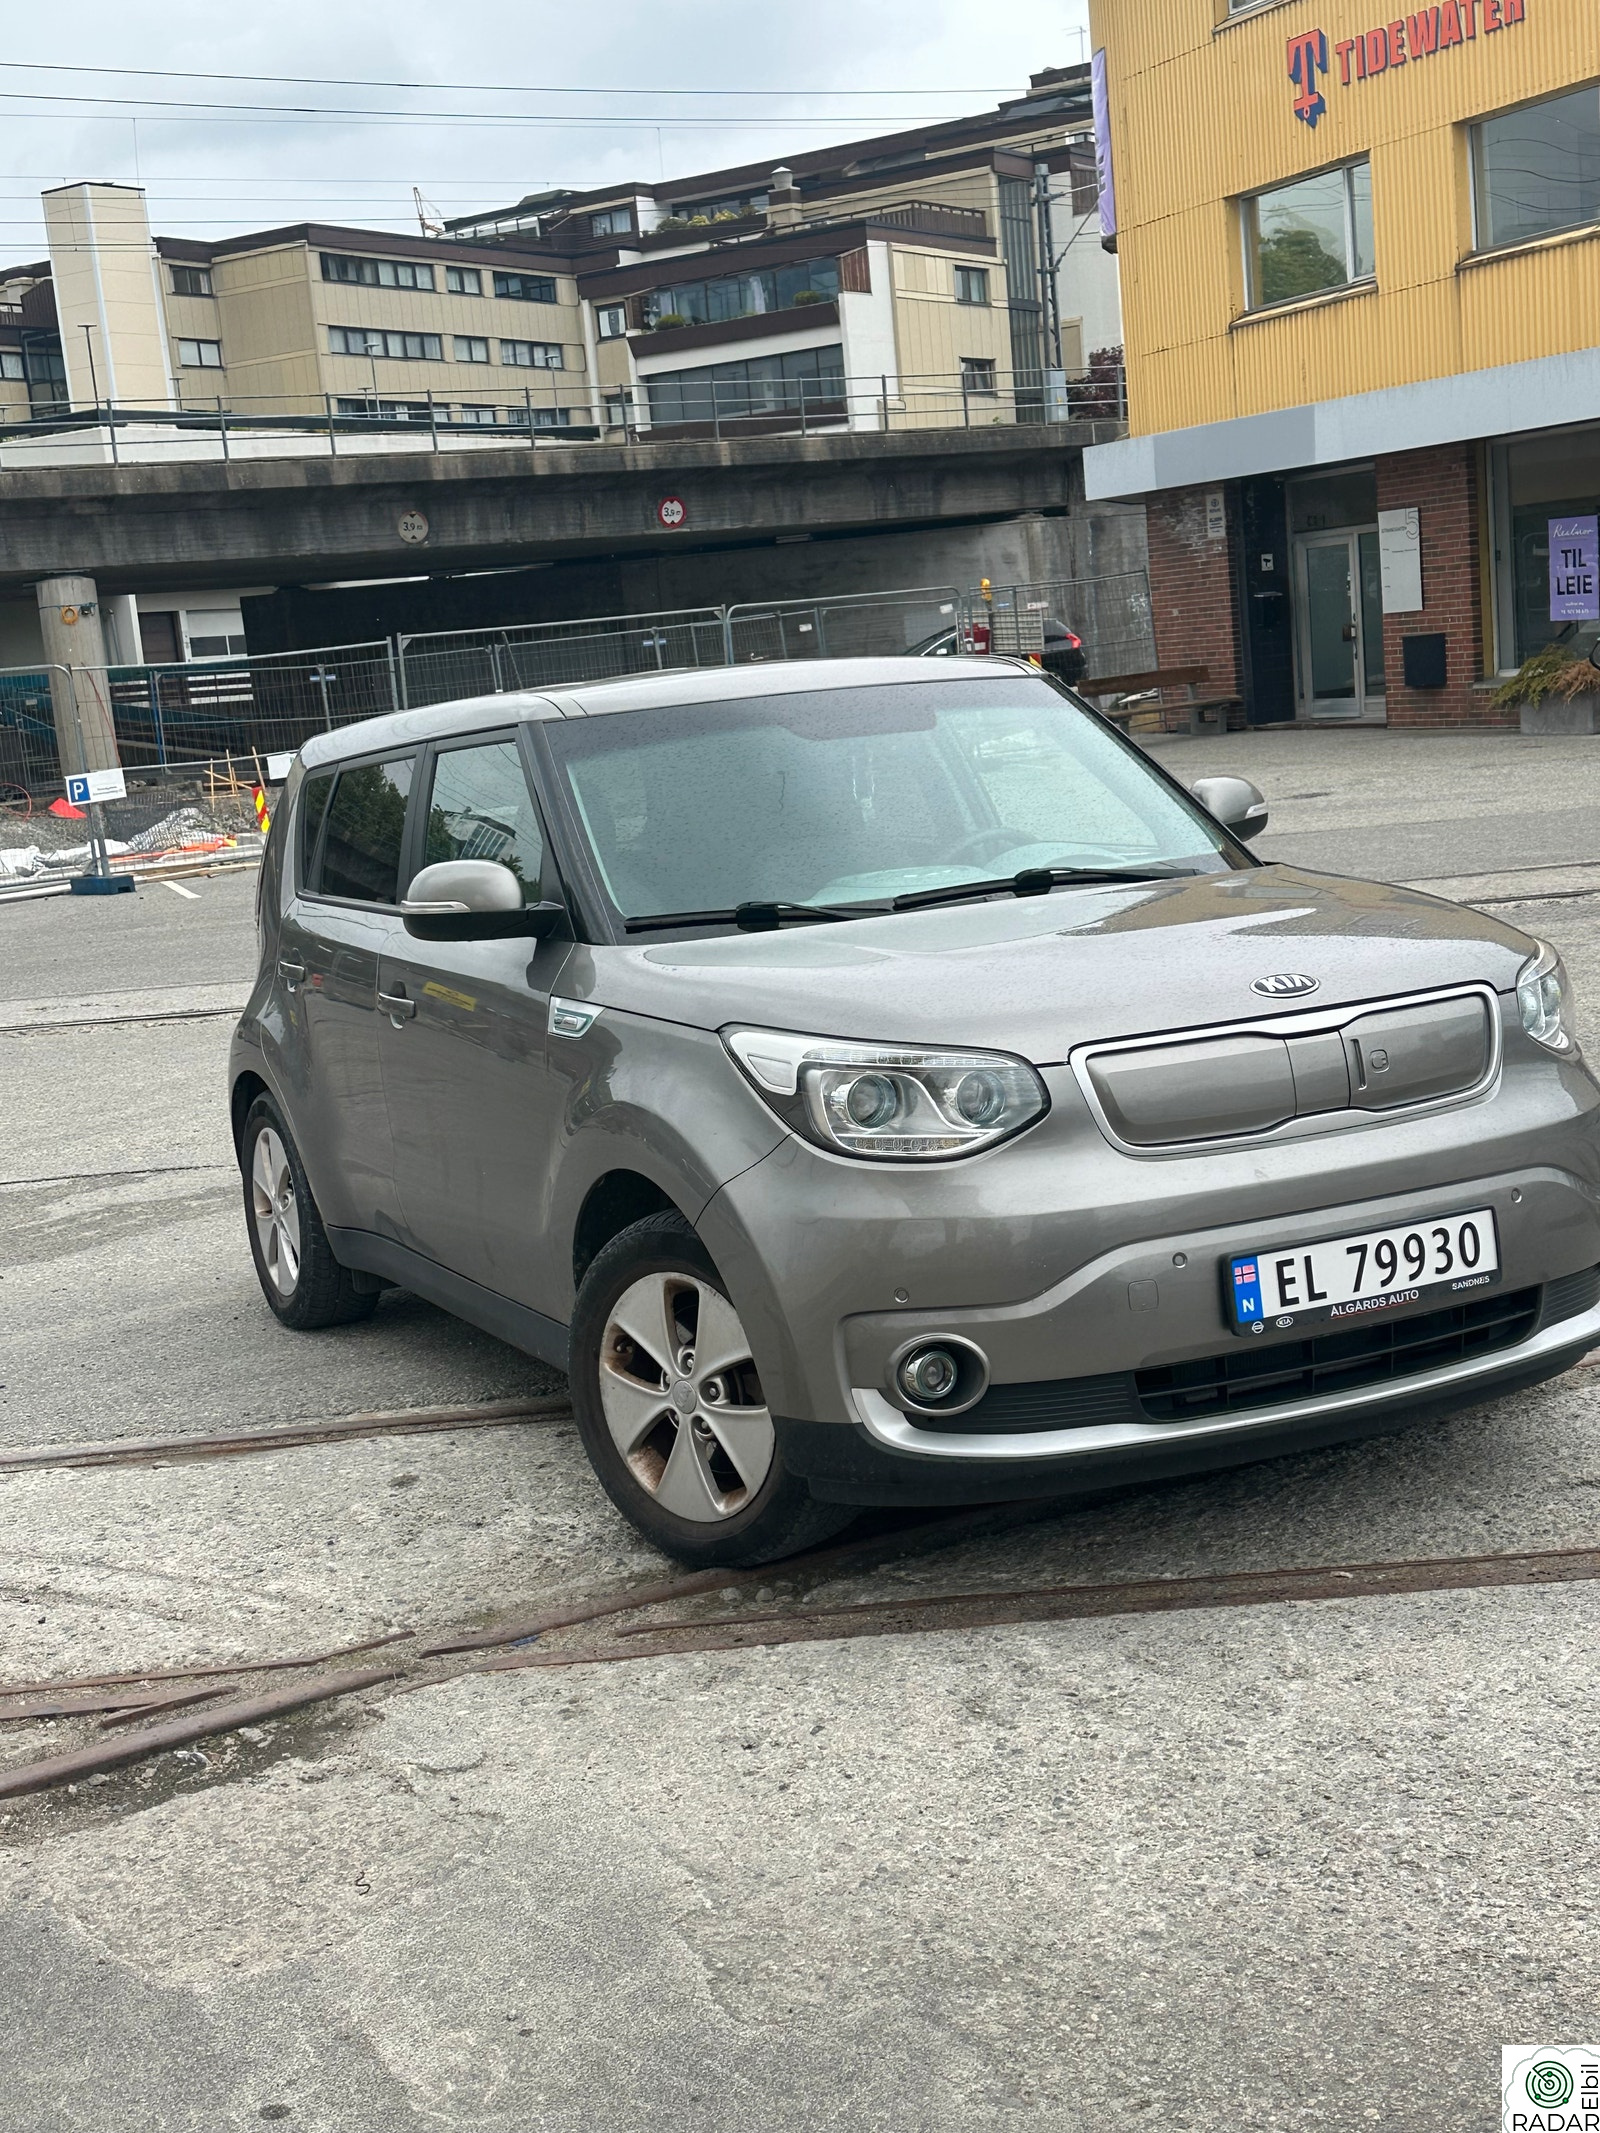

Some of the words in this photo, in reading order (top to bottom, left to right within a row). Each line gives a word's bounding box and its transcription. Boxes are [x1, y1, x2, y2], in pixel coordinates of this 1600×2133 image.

[1561, 548, 1587, 569] TIL
[1556, 574, 1593, 596] LEIE
[73, 781, 84, 801] P
[1259, 974, 1314, 993] KIA
[1276, 1255, 1327, 1308] EL
[1346, 1221, 1480, 1293] 79930
[1388, 1289, 1419, 1305] AUTO
[1452, 1275, 1490, 1290] SANDNES
[1242, 1298, 1255, 1313] N
